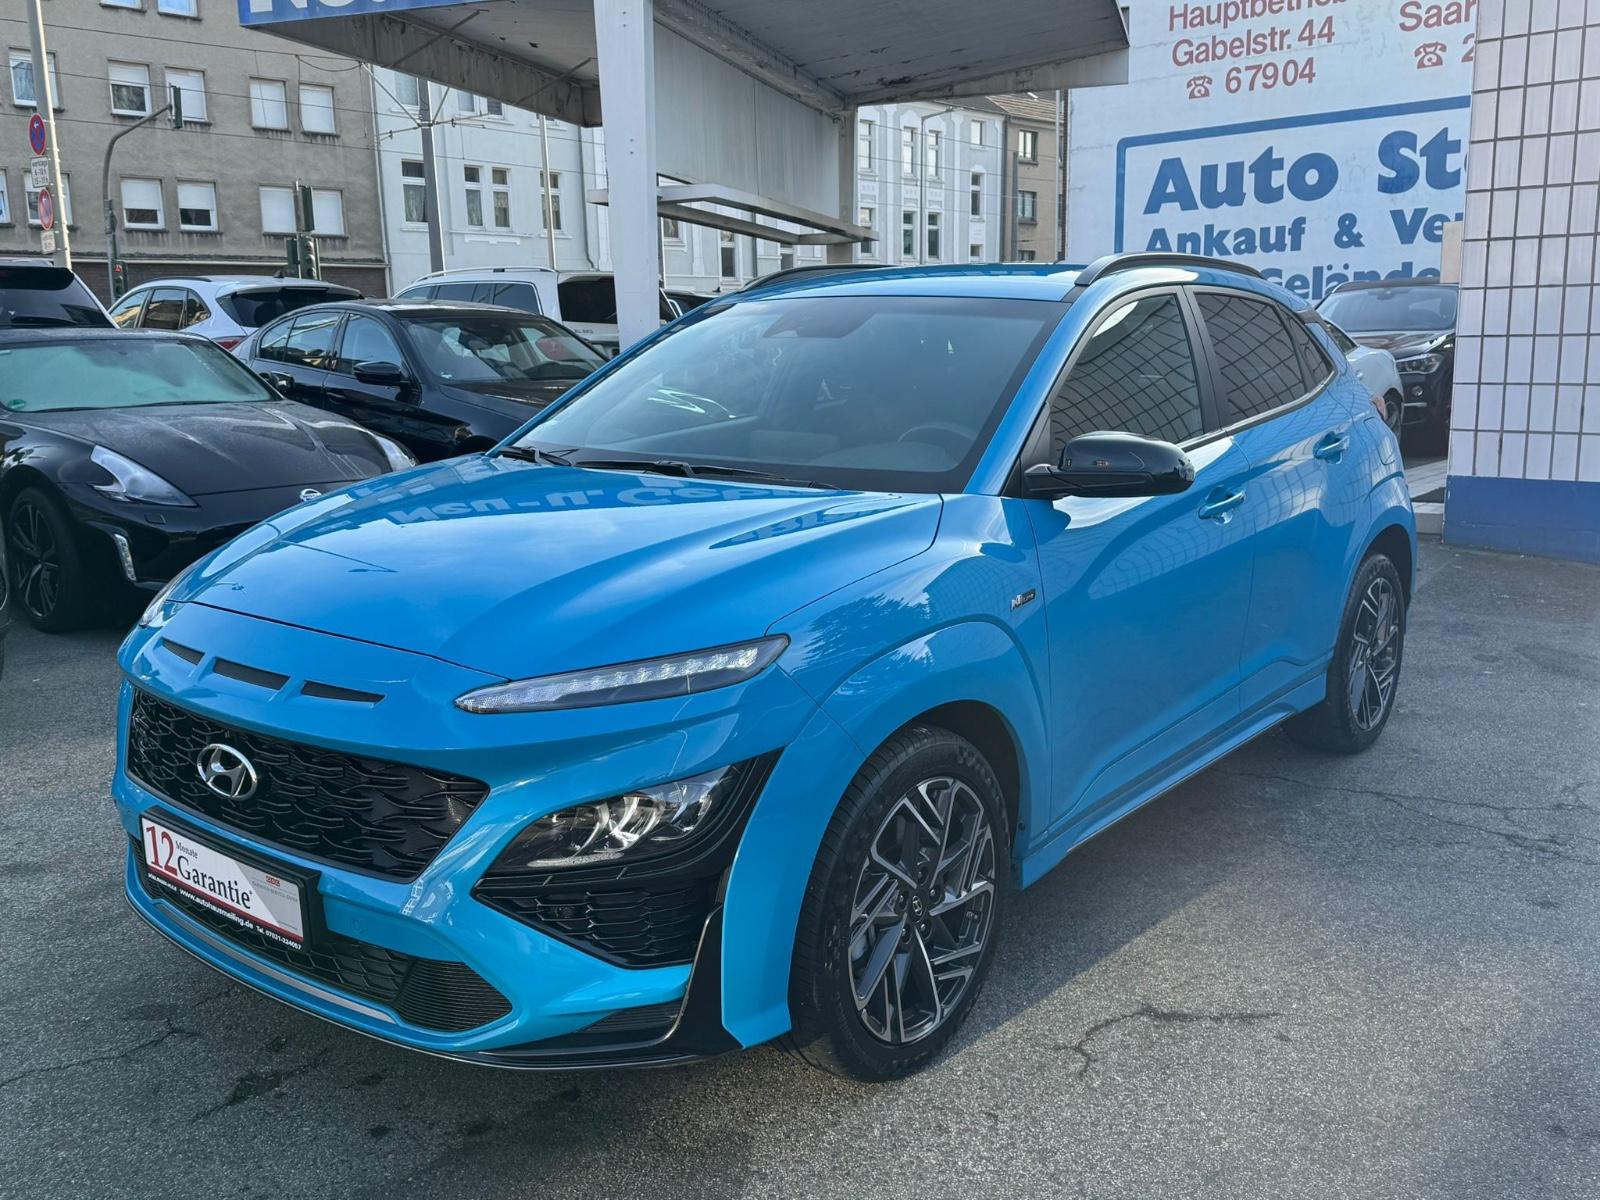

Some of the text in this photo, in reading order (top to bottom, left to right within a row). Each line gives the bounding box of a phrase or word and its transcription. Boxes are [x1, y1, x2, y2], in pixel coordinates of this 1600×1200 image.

[1169, 0, 1347, 31] Hauptbet
[1172, 16, 1335, 67] Gabelstr. 44
[1225, 57, 1316, 94] 67904
[1143, 127, 1467, 214] Auto St
[1146, 216, 1307, 257] Ankauf
[1334, 213, 1365, 249] &
[146, 826, 178, 876] 12
[177, 855, 251, 910] Garantie
